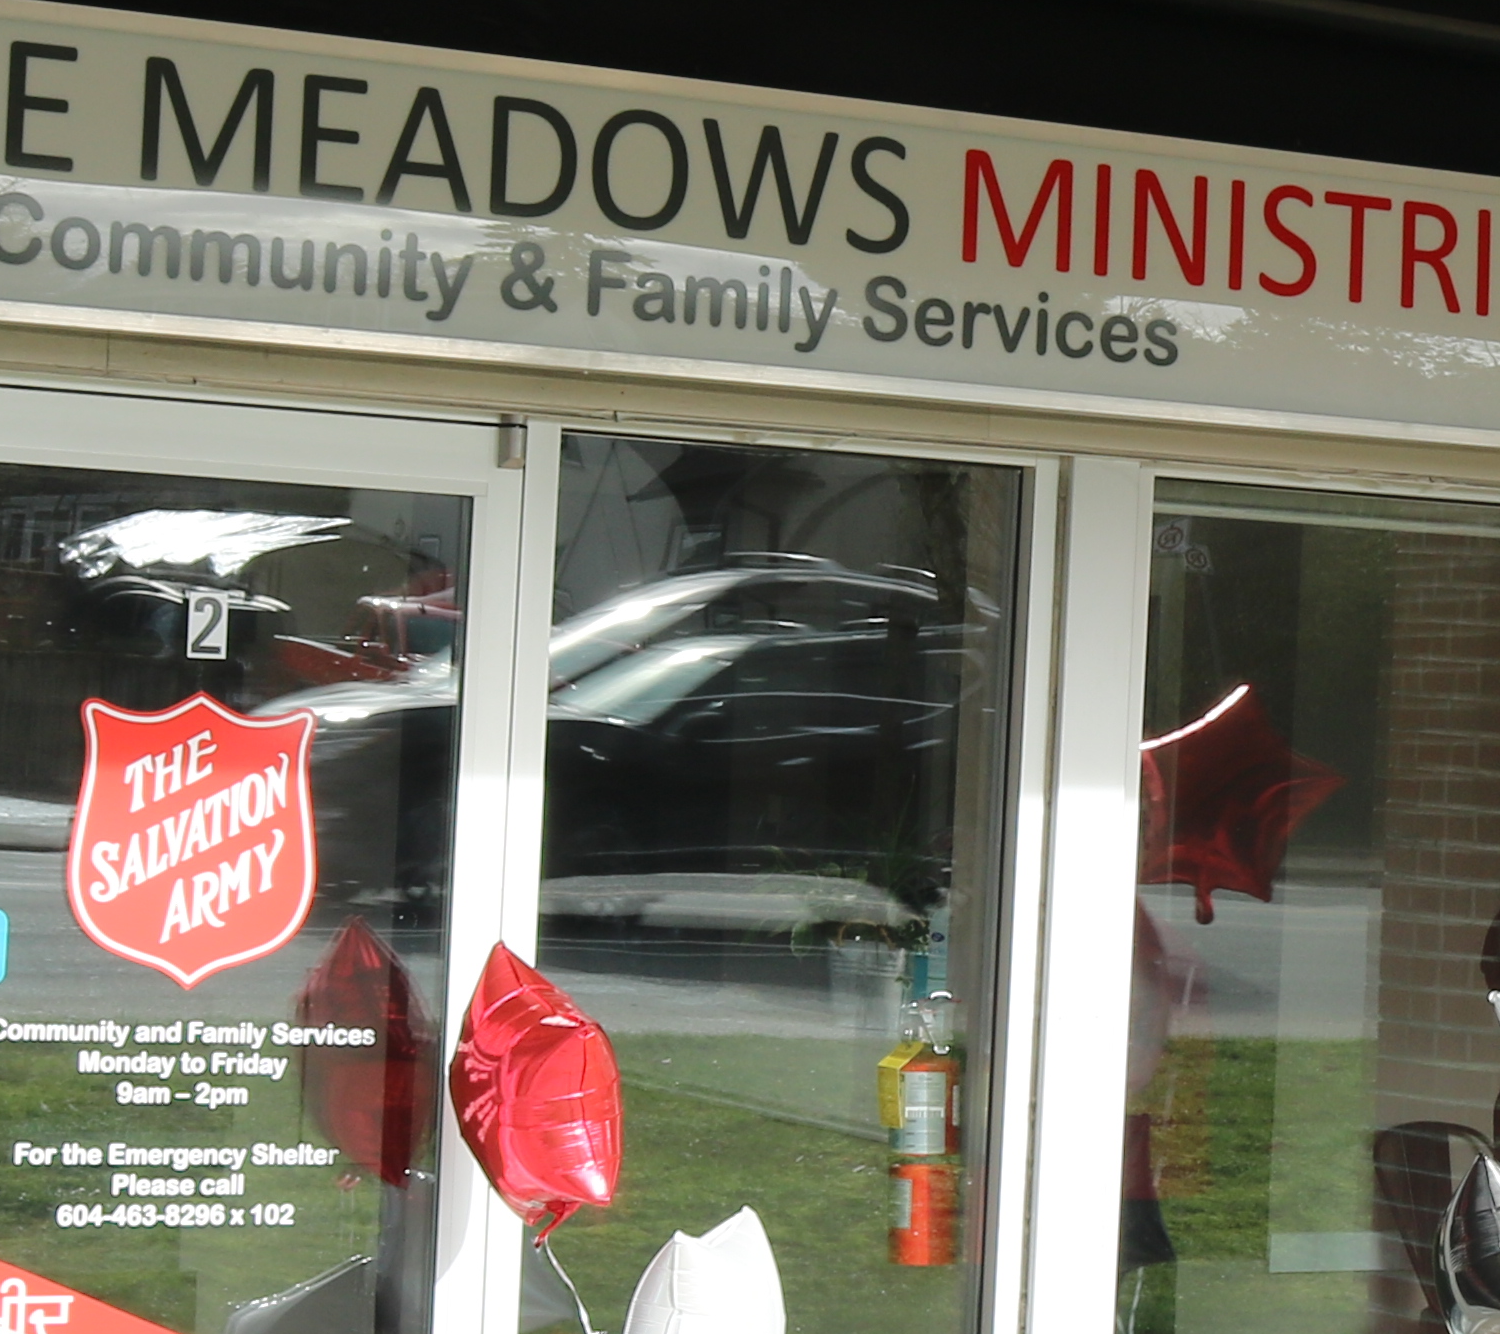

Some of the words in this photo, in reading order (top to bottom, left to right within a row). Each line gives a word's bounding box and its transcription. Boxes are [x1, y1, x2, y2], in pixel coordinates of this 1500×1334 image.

[140, 55, 910, 255] MEADOWS
[500, 241, 560, 315] &
[587, 248, 838, 353] Family
[862, 277, 1180, 369] Services
[191, 597, 221, 655] 2
[123, 729, 217, 814] THE
[89, 752, 289, 903] SALVATION
[158, 829, 284, 945] ARMY
[135, 1023, 182, 1045] and
[187, 1021, 267, 1050] Family
[272, 1023, 375, 1047] Services
[78, 1051, 176, 1080] Monday
[180, 1054, 206, 1075] to
[211, 1051, 288, 1080] Friday
[116, 1082, 171, 1105] 9am
[195, 1082, 248, 1109] 2pm
[13, 1143, 57, 1166] For
[62, 1143, 102, 1166] the
[107, 1143, 246, 1172] Emergency
[251, 1144, 339, 1166] Shelter
[111, 1173, 194, 1197] Please
[200, 1173, 245, 1197] call
[56, 1204, 225, 1227] 604-463-8296
[229, 1210, 244, 1226] x
[249, 1204, 295, 1227] 102
